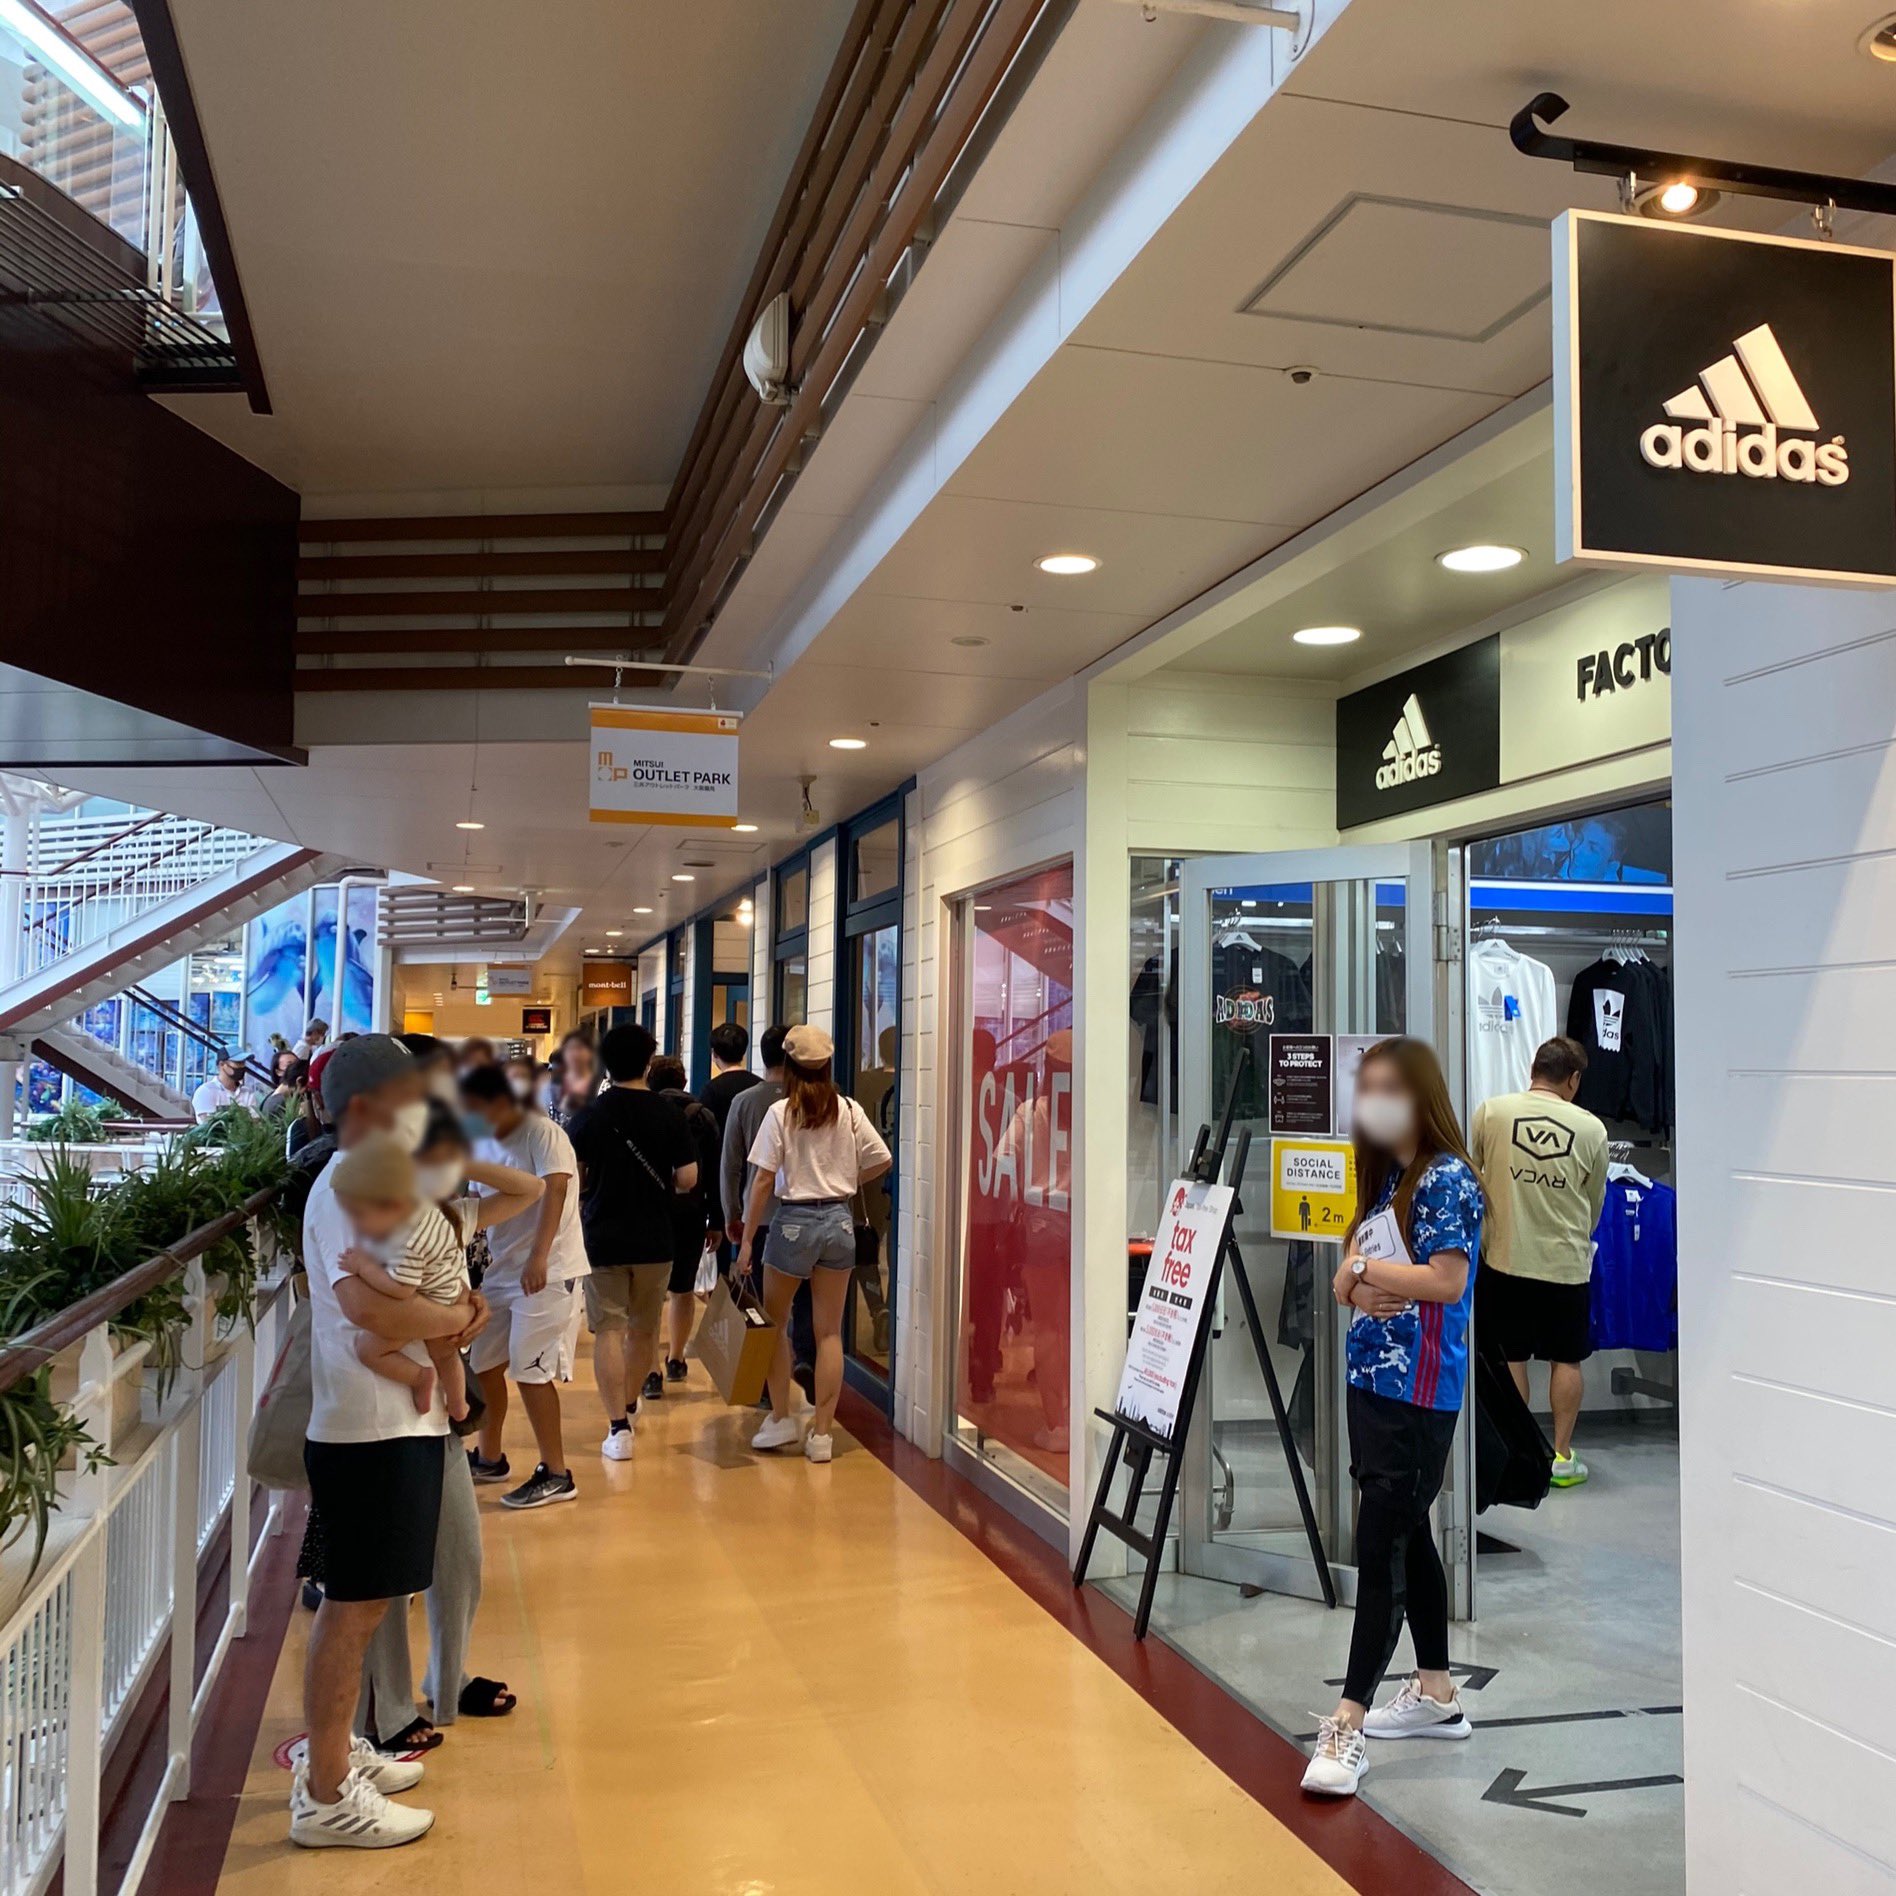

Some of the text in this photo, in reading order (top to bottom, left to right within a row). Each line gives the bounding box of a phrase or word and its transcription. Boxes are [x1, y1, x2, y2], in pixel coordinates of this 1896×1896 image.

[1640, 417, 1850, 486] adidas
[633, 759, 664, 768] MITSUI
[1375, 748, 1442, 790] adidas
[632, 768, 731, 785] OUTLET PARK
[1290, 1060, 1323, 1068] PROTECT
[978, 1071, 1070, 1213] SALE
[1293, 1157, 1334, 1168] SOCIAL
[1286, 1168, 1341, 1180] DISTANCE
[1321, 1206, 1331, 1222] 2
[1171, 1220, 1197, 1254] tax
[1160, 1250, 1191, 1288] free
